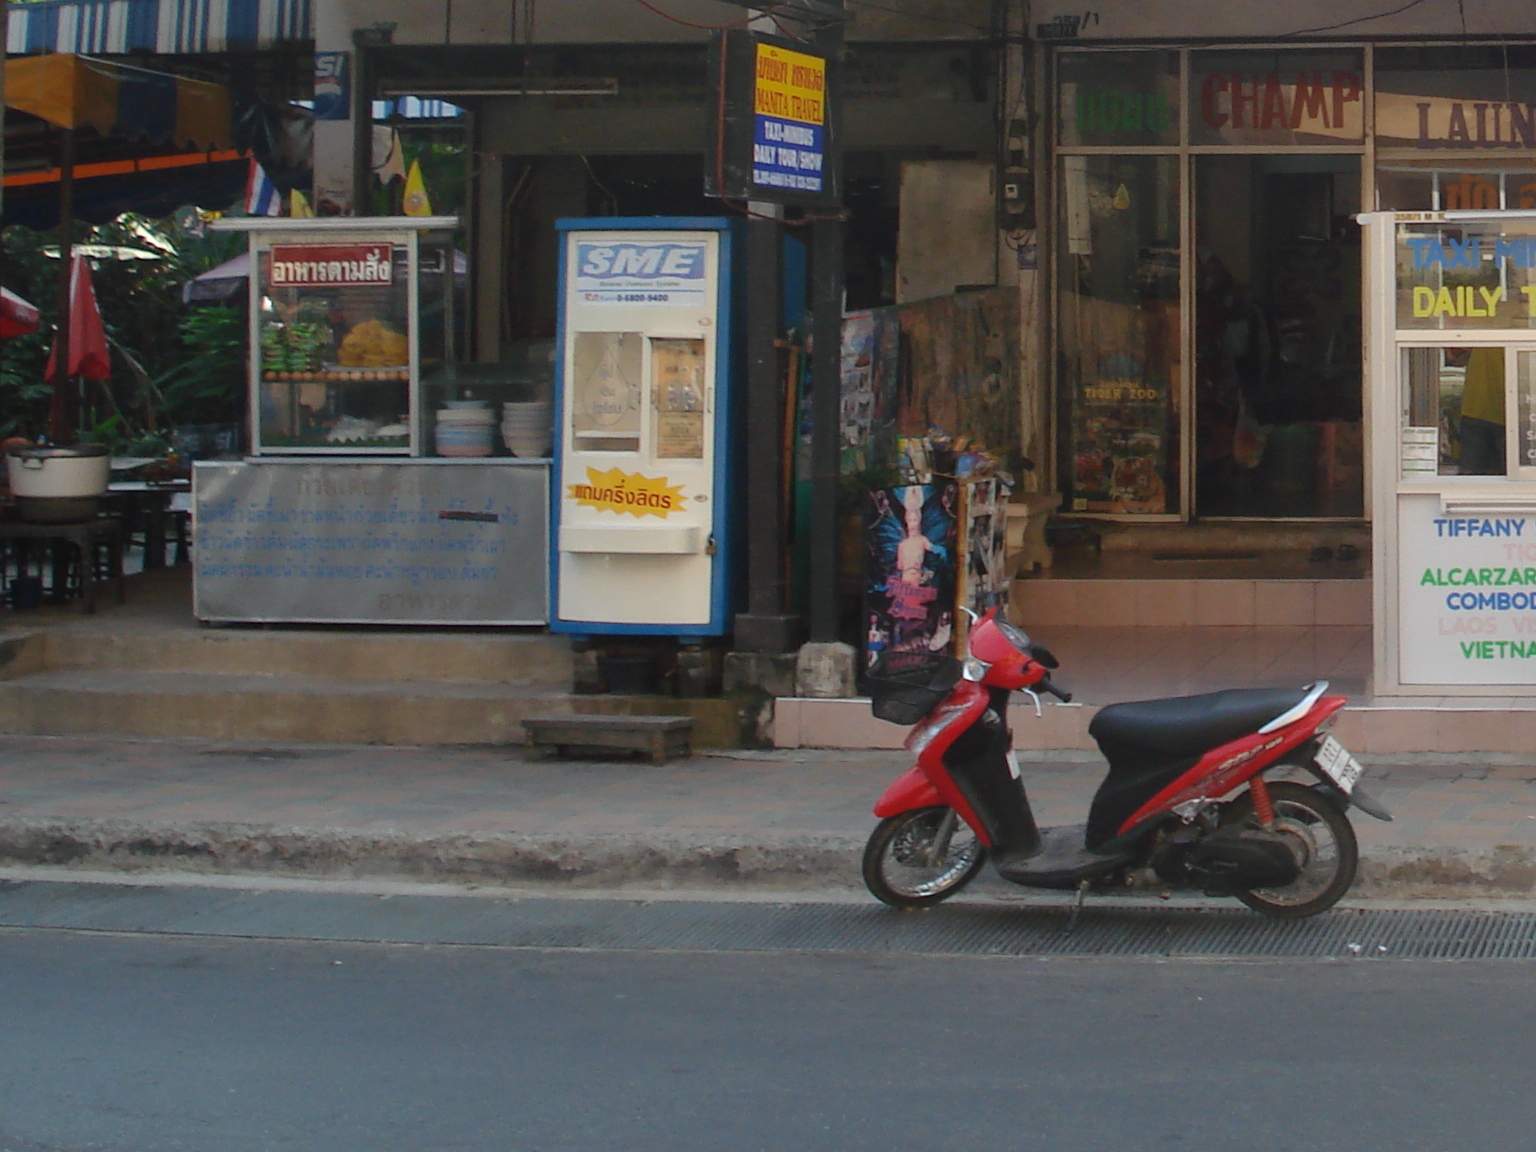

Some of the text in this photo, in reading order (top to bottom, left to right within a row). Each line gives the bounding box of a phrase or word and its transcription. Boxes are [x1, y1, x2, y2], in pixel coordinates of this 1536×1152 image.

[791, 95, 823, 122] TRAVEL
[1201, 73, 1363, 130] CHAMP
[753, 143, 777, 165] DAILY
[272, 249, 391, 283] อาหารตามสั่ง
[583, 248, 699, 276] SME
[1407, 237, 1481, 269] TAXI
[1412, 286, 1503, 318] DAILY
[1084, 387, 1156, 399] TIGER ZOO
[575, 478, 672, 509] แถมครึ่งลิตร
[1432, 519, 1526, 538] TIFFANY
[1438, 617, 1498, 636] LAOS
